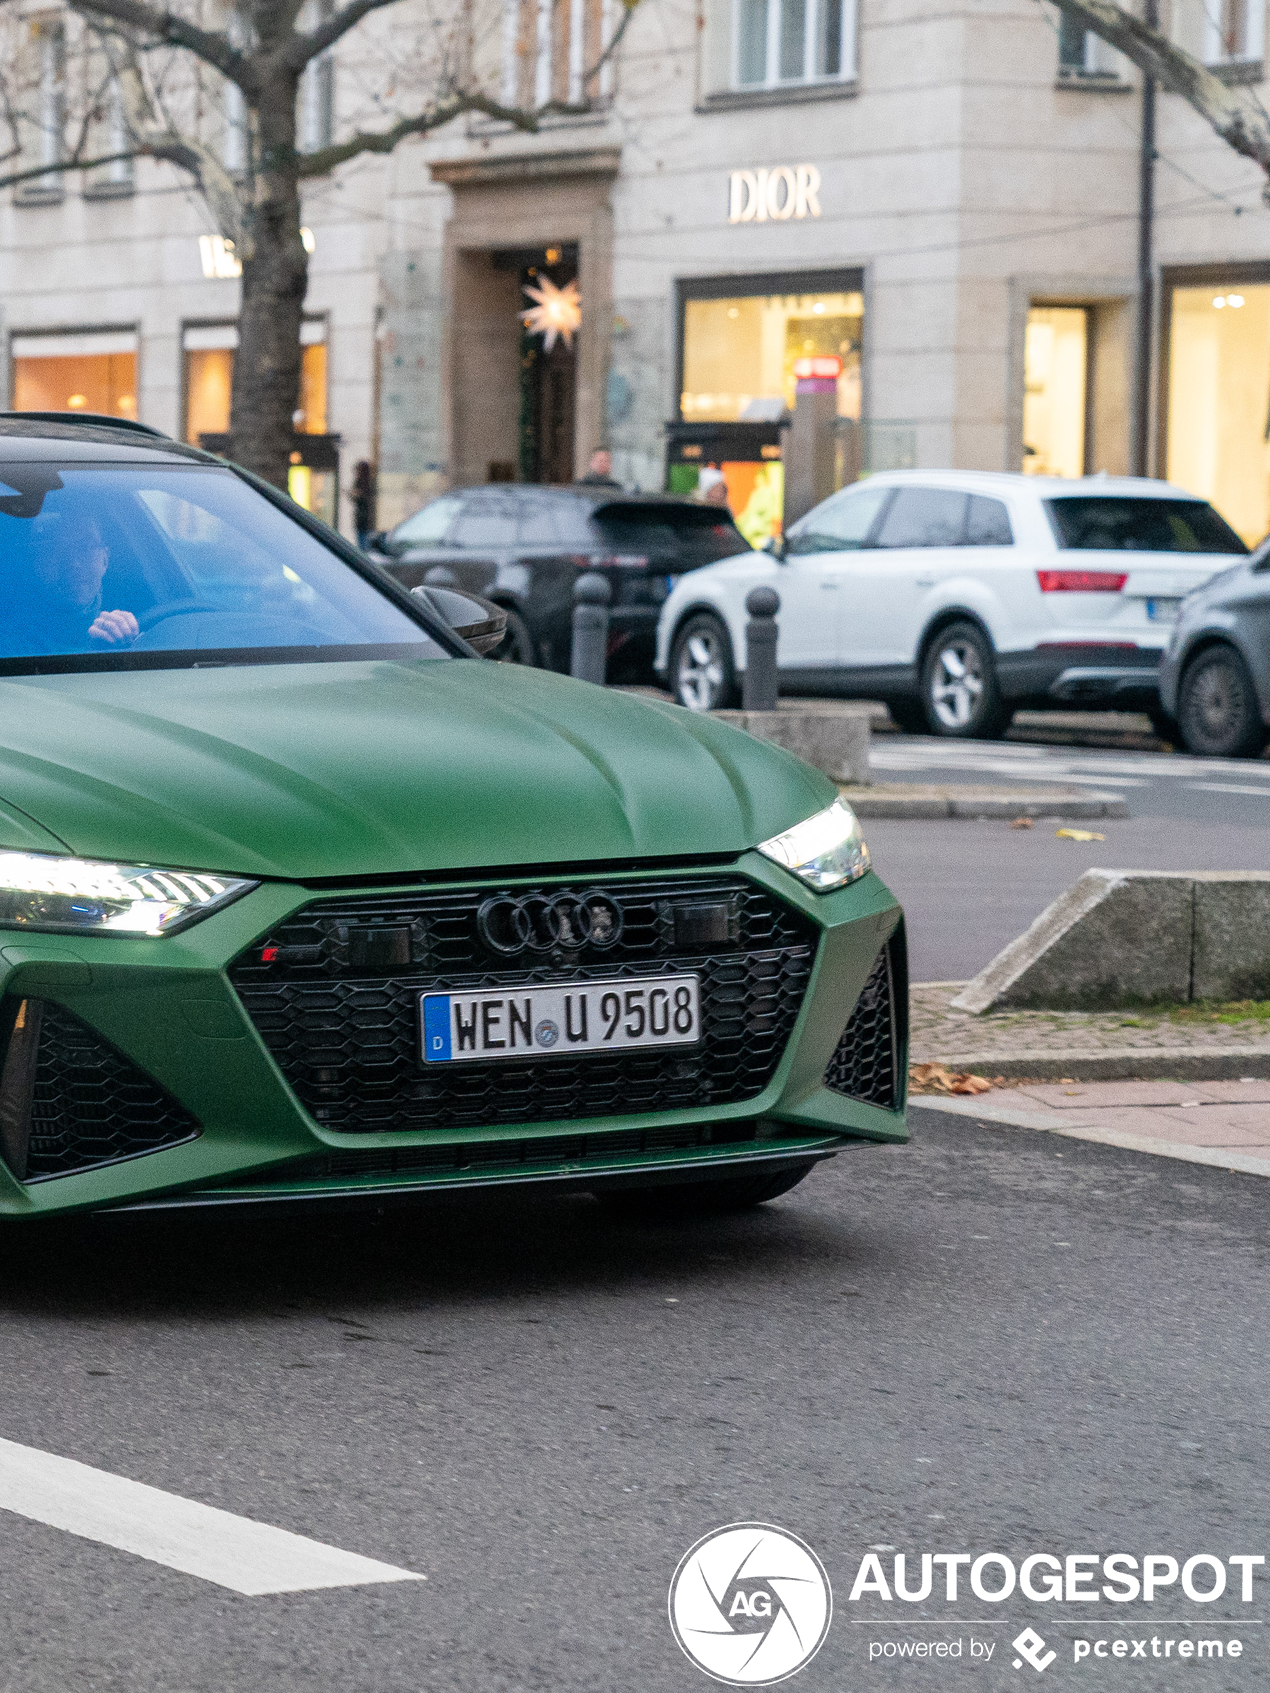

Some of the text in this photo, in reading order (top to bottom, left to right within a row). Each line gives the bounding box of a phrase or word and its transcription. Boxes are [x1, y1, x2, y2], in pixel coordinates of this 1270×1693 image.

[728, 164, 821, 224] DIOR
[432, 1036, 444, 1050] D
[453, 985, 693, 1051] WEN U 9508
